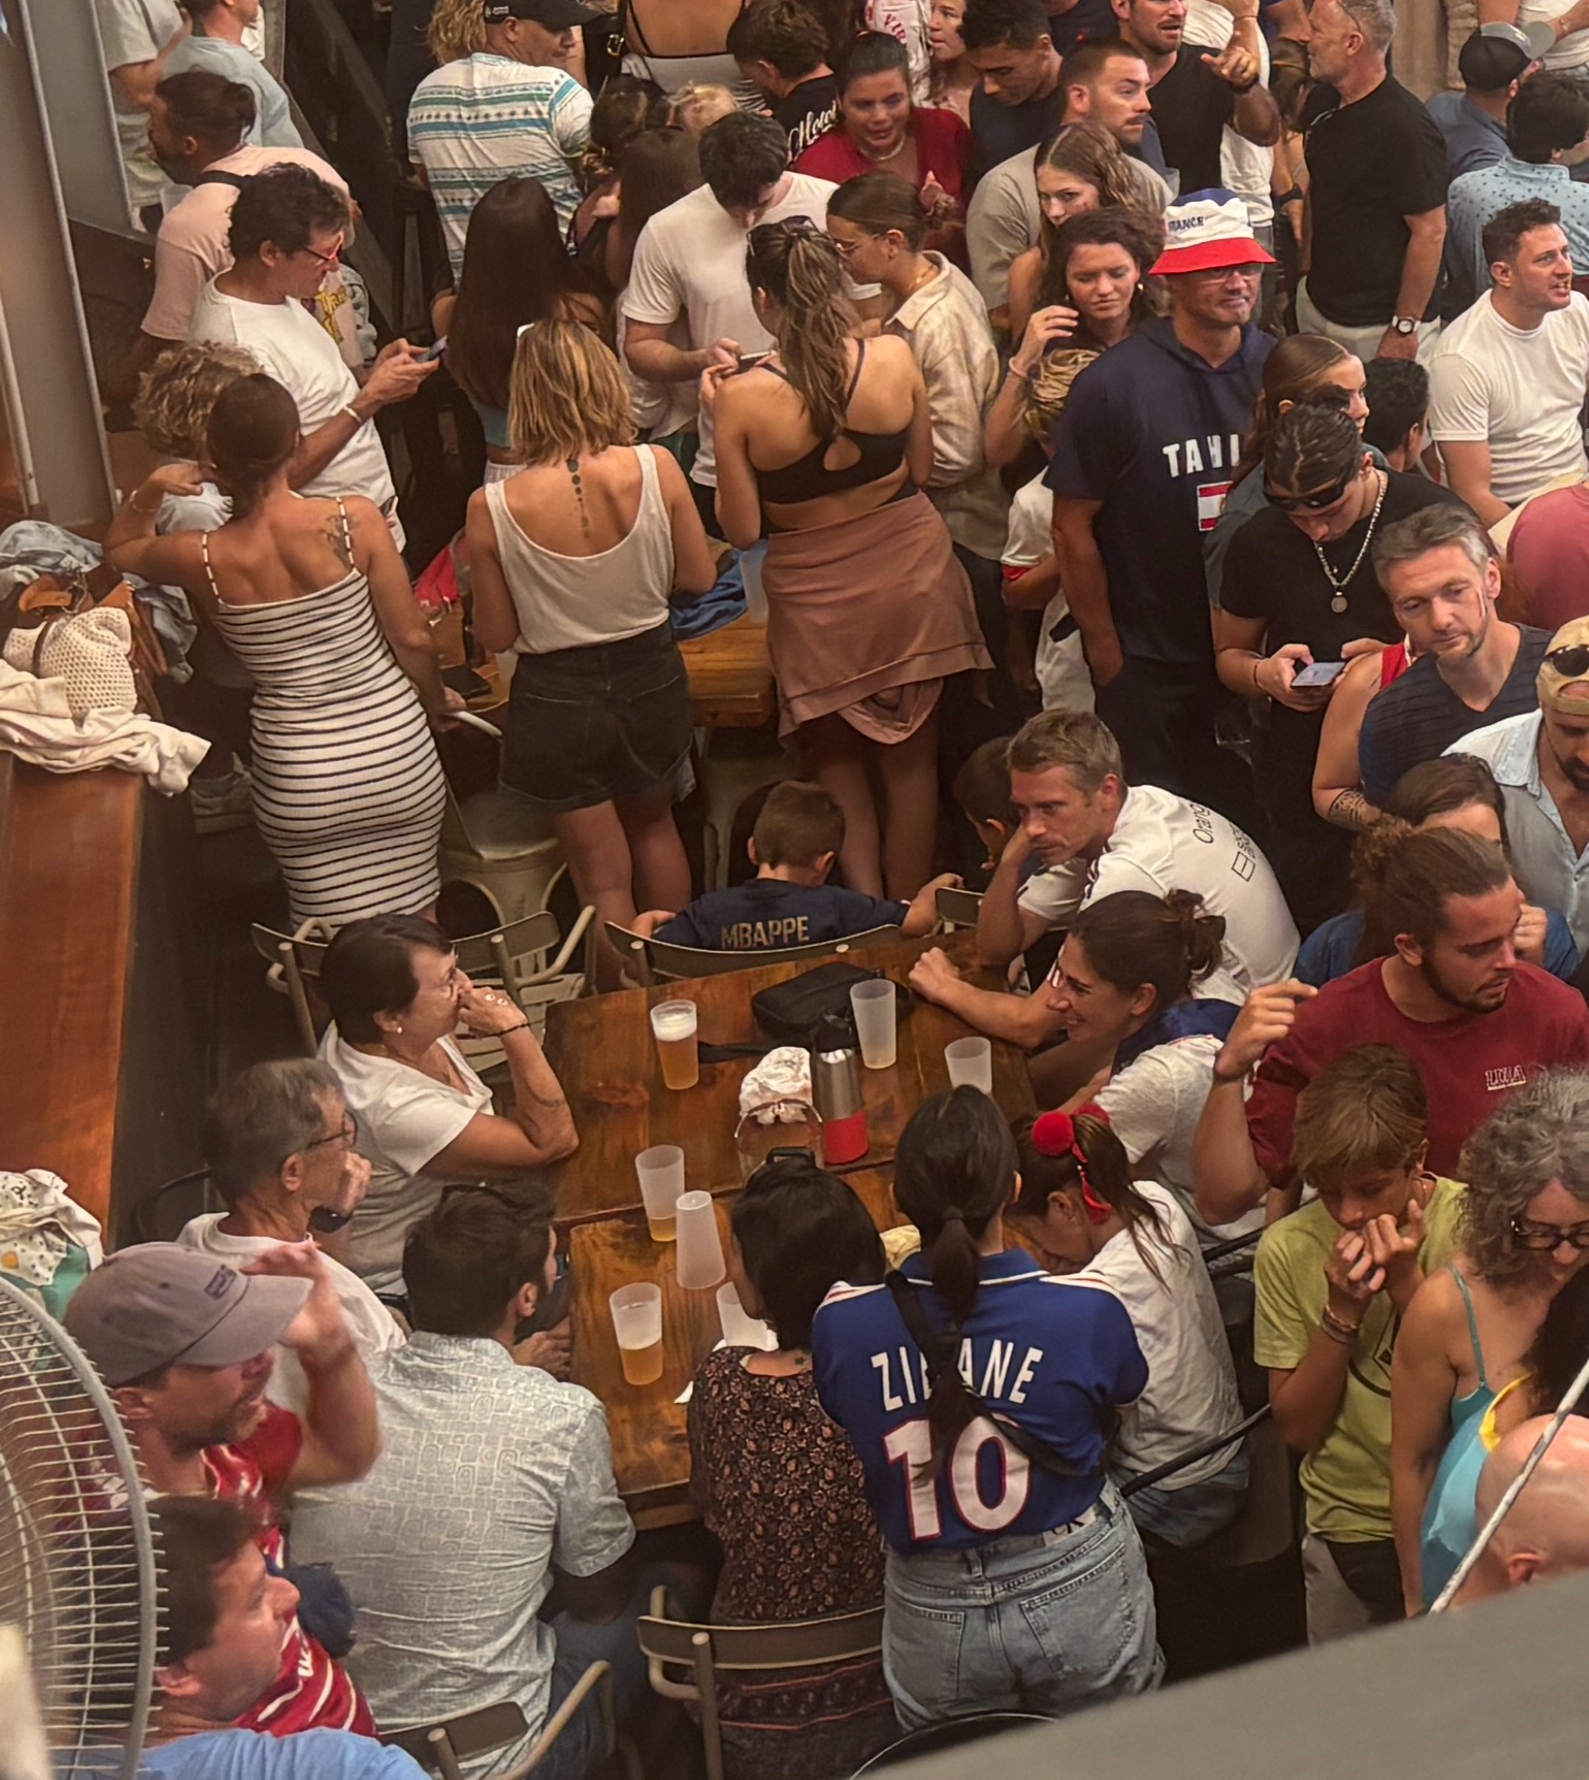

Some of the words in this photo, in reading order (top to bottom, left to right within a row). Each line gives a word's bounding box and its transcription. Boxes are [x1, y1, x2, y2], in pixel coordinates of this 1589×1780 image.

[1162, 433, 1240, 478] TAHI
[1189, 803, 1214, 844] Orang
[721, 916, 810, 950] MBAPPE
[881, 1415, 1033, 1541] 10
